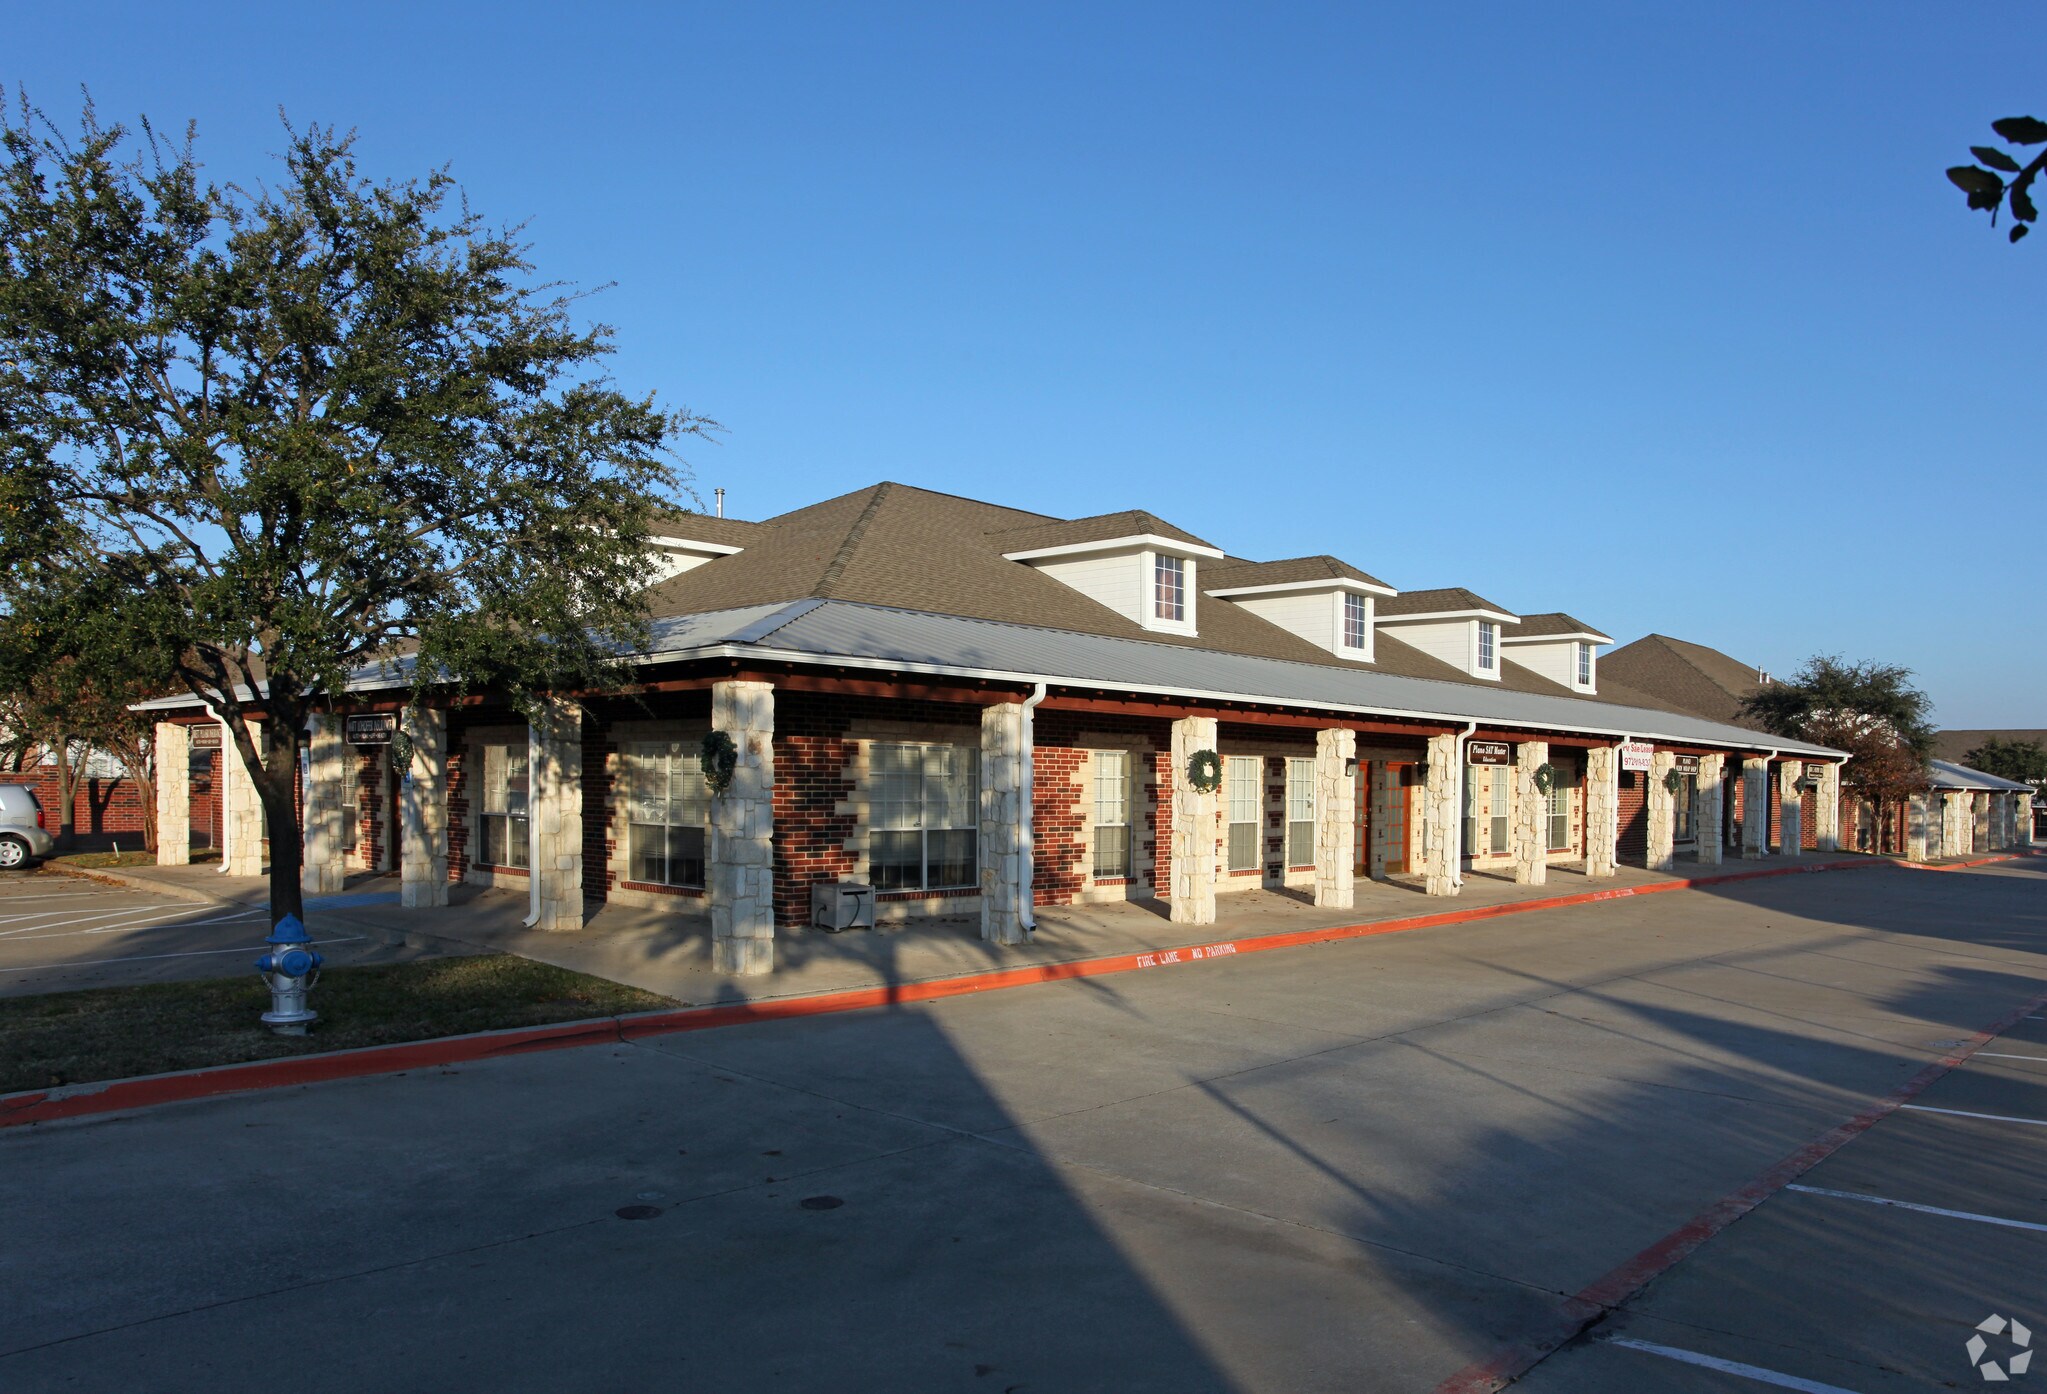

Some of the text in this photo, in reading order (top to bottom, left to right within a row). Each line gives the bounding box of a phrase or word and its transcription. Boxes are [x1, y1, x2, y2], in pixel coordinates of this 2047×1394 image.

[1473, 745, 1485, 754] Plano
[1136, 943, 1237, 968] FIRE LANE NO PARKING
